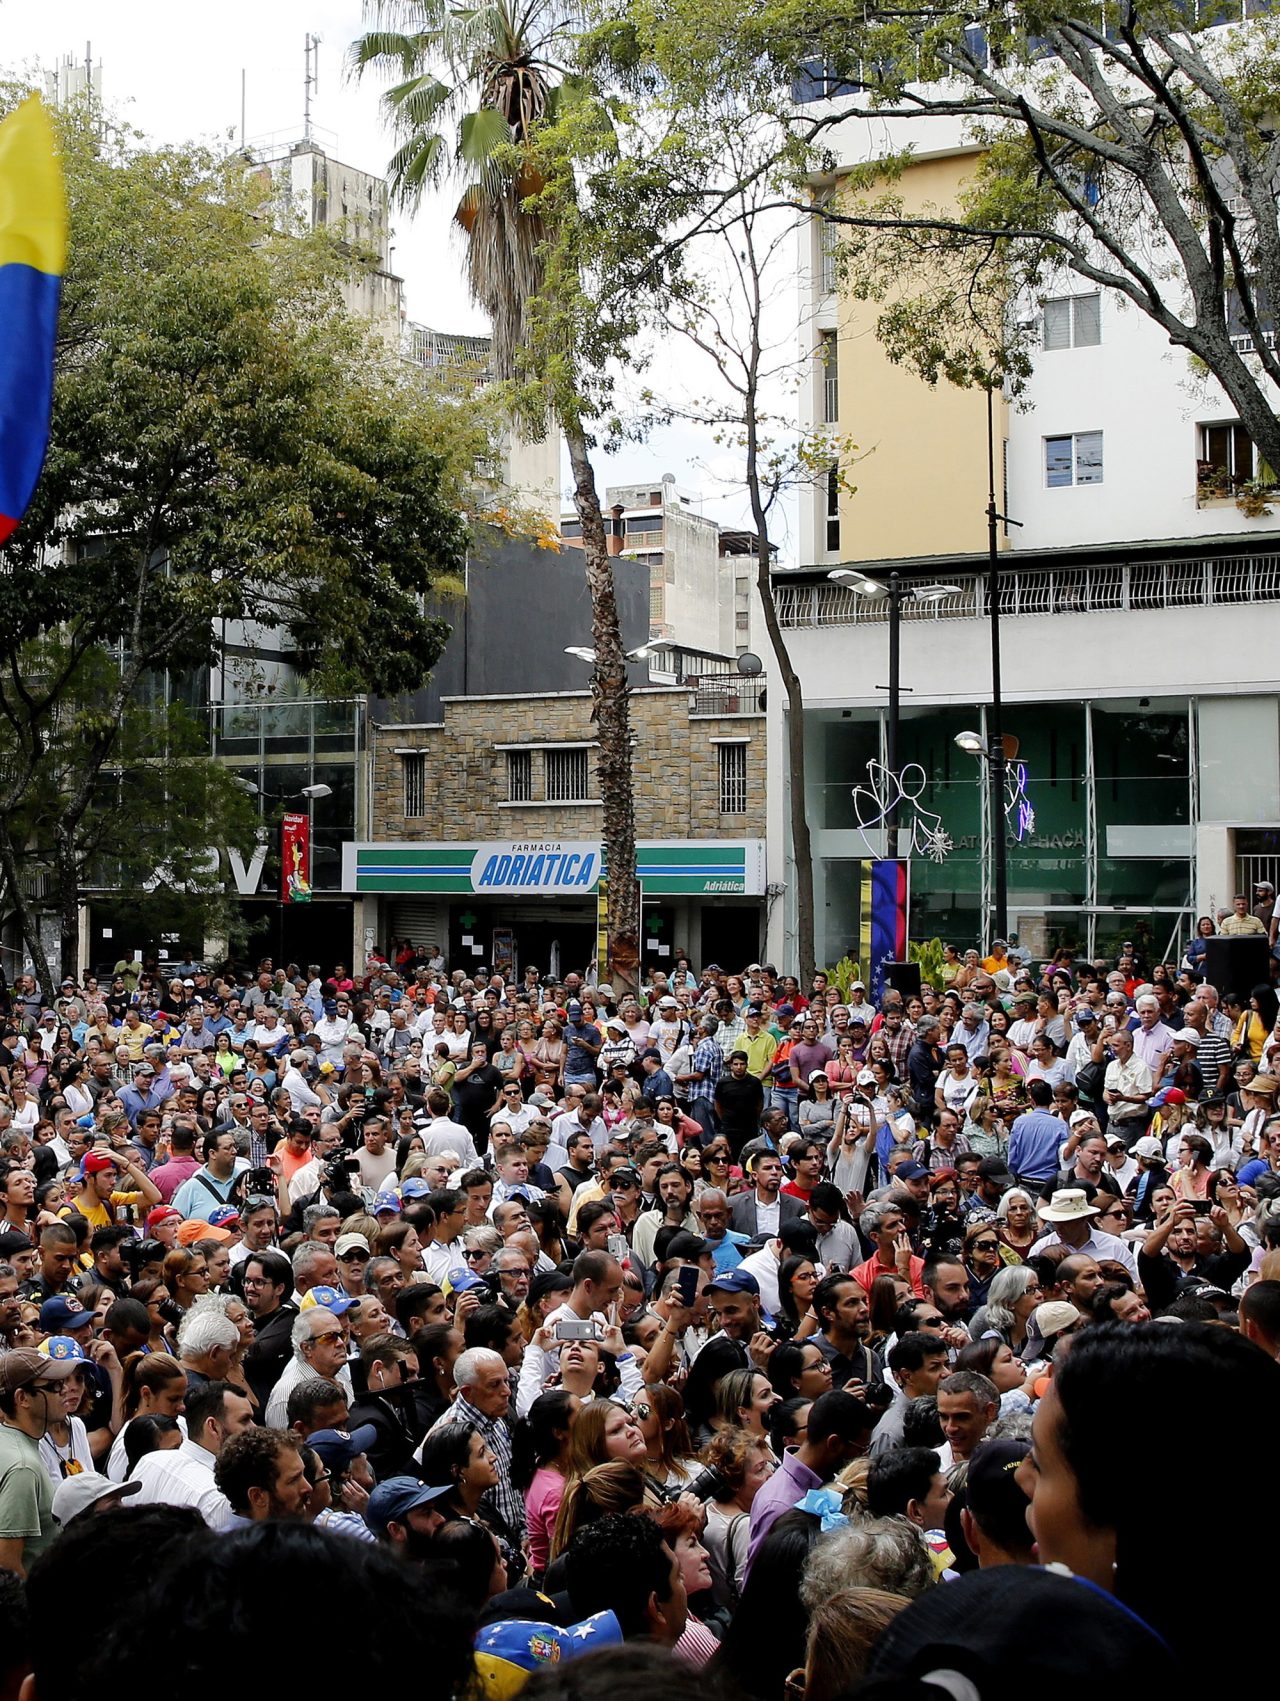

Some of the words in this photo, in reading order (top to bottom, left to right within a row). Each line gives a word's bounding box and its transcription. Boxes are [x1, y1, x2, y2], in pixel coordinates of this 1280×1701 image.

[511, 843, 562, 852] FARMACIA
[478, 853, 595, 886] ADRIATICA
[703, 880, 745, 892] Adriática
